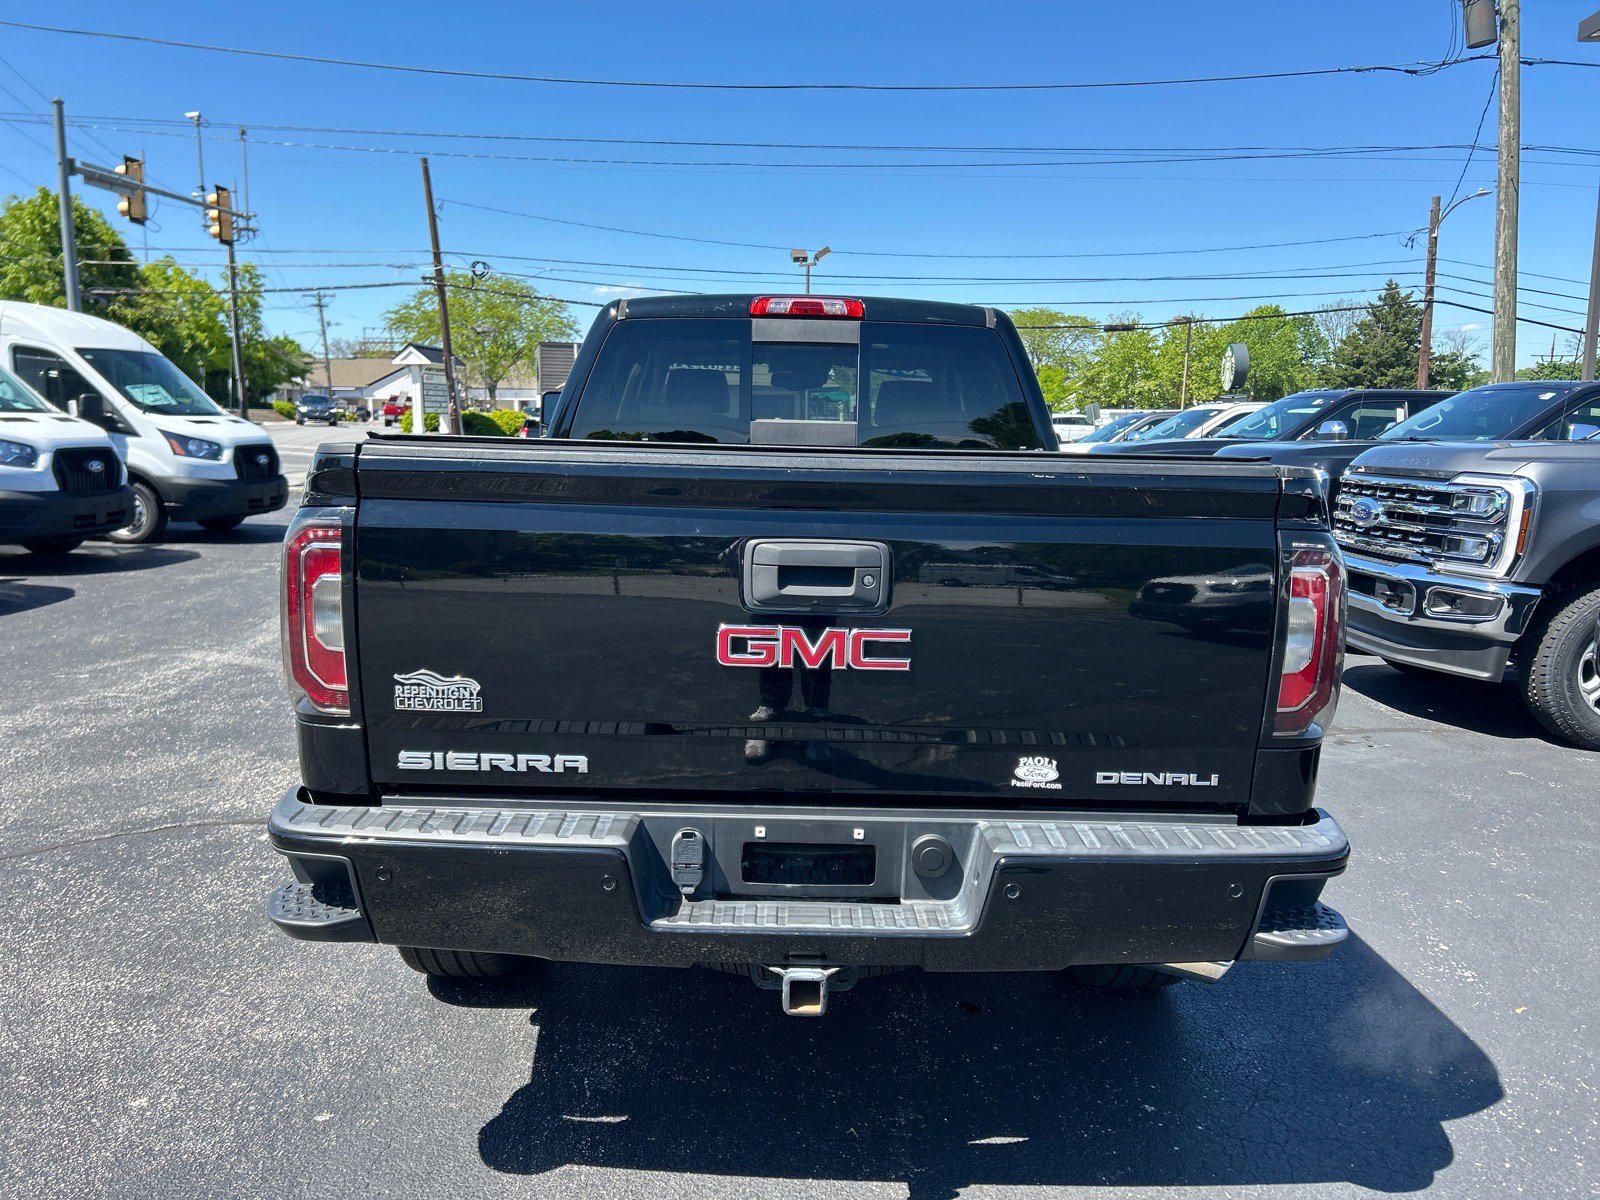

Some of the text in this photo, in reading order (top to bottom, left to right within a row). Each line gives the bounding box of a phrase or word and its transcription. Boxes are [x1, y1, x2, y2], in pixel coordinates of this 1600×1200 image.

[716, 623, 912, 671] GMC
[395, 685, 481, 699] REPENTIGNY
[396, 697, 481, 710] CHEVROLET
[398, 751, 589, 773] SIERRA
[1018, 756, 1058, 770] PAOLI
[1023, 768, 1050, 779] Ford
[1096, 772, 1219, 786] DENALI
[1011, 779, 1063, 790] PaoliFord.com
